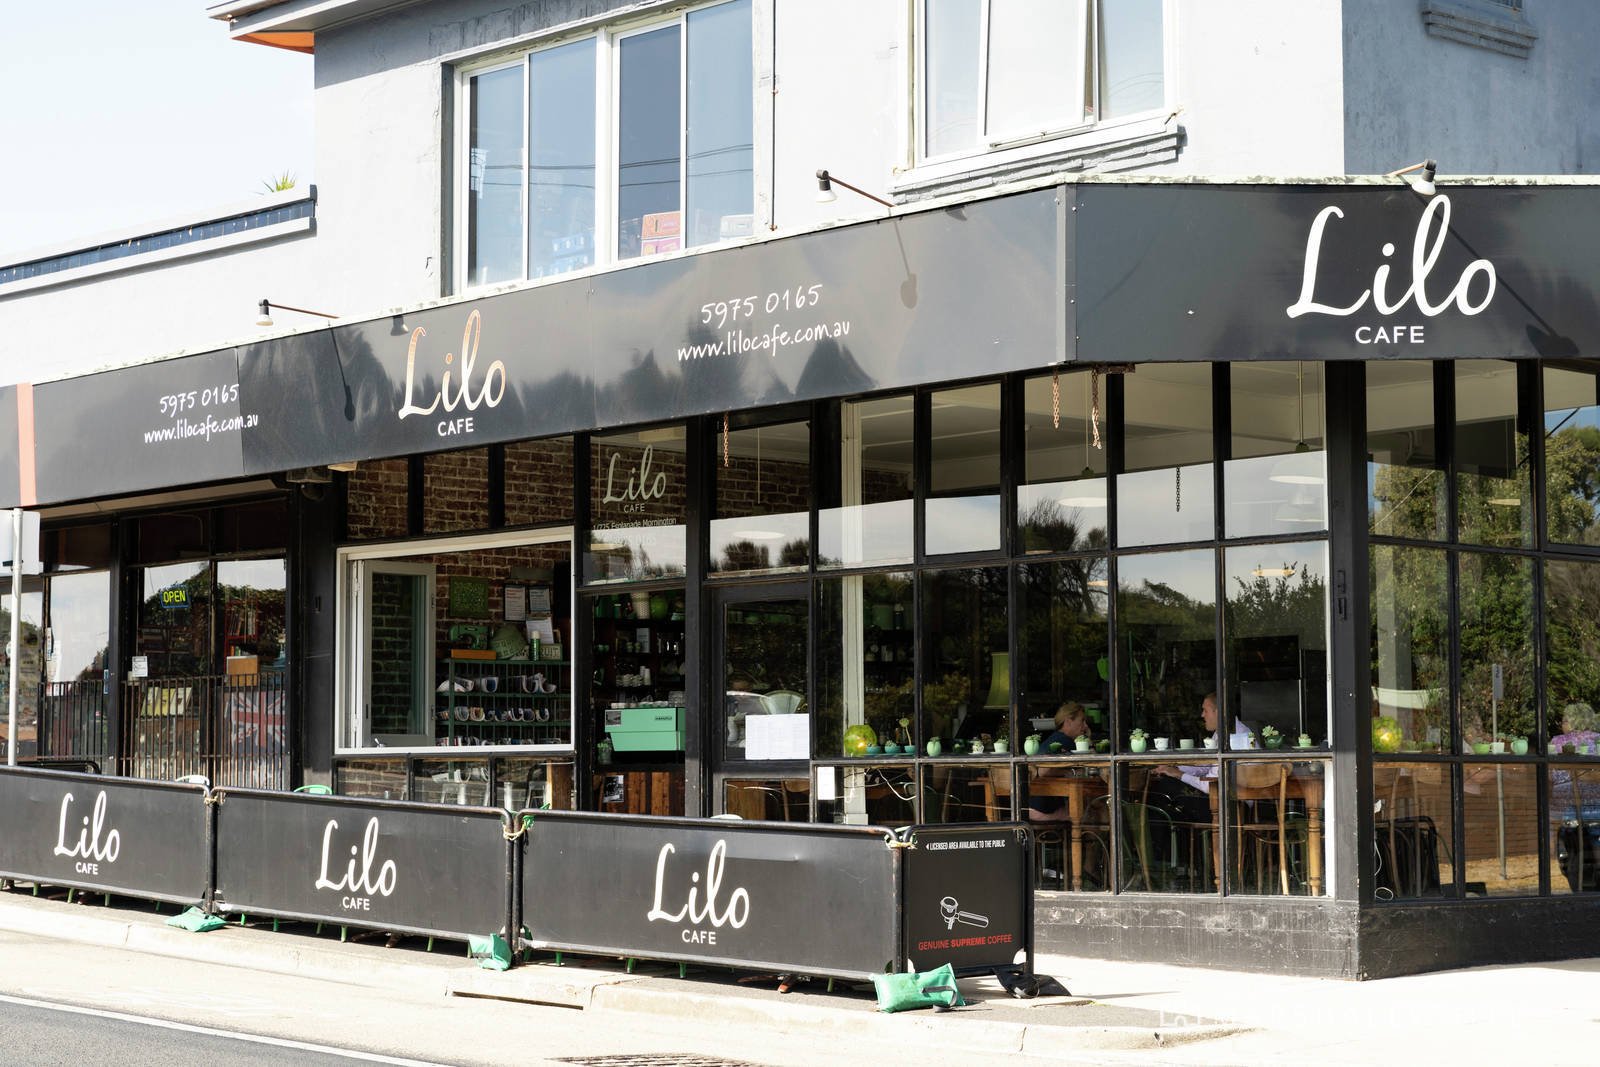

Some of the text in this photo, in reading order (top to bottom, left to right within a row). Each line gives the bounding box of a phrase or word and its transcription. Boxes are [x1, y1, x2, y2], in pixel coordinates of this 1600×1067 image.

[1286, 194, 1497, 319] Lilo
[701, 284, 823, 327] 5975 0165
[677, 319, 851, 363] www.lilocafe.com.au
[1355, 326, 1425, 344] CAFE
[398, 309, 506, 421] Lilo
[159, 383, 240, 417] 5975 0165
[143, 413, 259, 443] www.lilocafe.com.au
[437, 417, 475, 437] CAFE
[602, 444, 666, 504] Lilo
[623, 503, 646, 514] CAFE
[642, 517, 677, 527] Mornington
[163, 590, 186, 603] OPEN
[53, 790, 121, 862] Lilo
[314, 816, 397, 897] Lilo
[930, 842, 948, 850] LICENSED
[949, 841, 959, 849] AREA
[959, 841, 979, 849] AVAILABLE
[75, 862, 99, 876] CAFE
[647, 839, 750, 929] Lilo
[342, 896, 371, 911] CAFE
[681, 930, 718, 945] CAFE
[918, 934, 1012, 950] GENUINE SUPREME COFFEE
